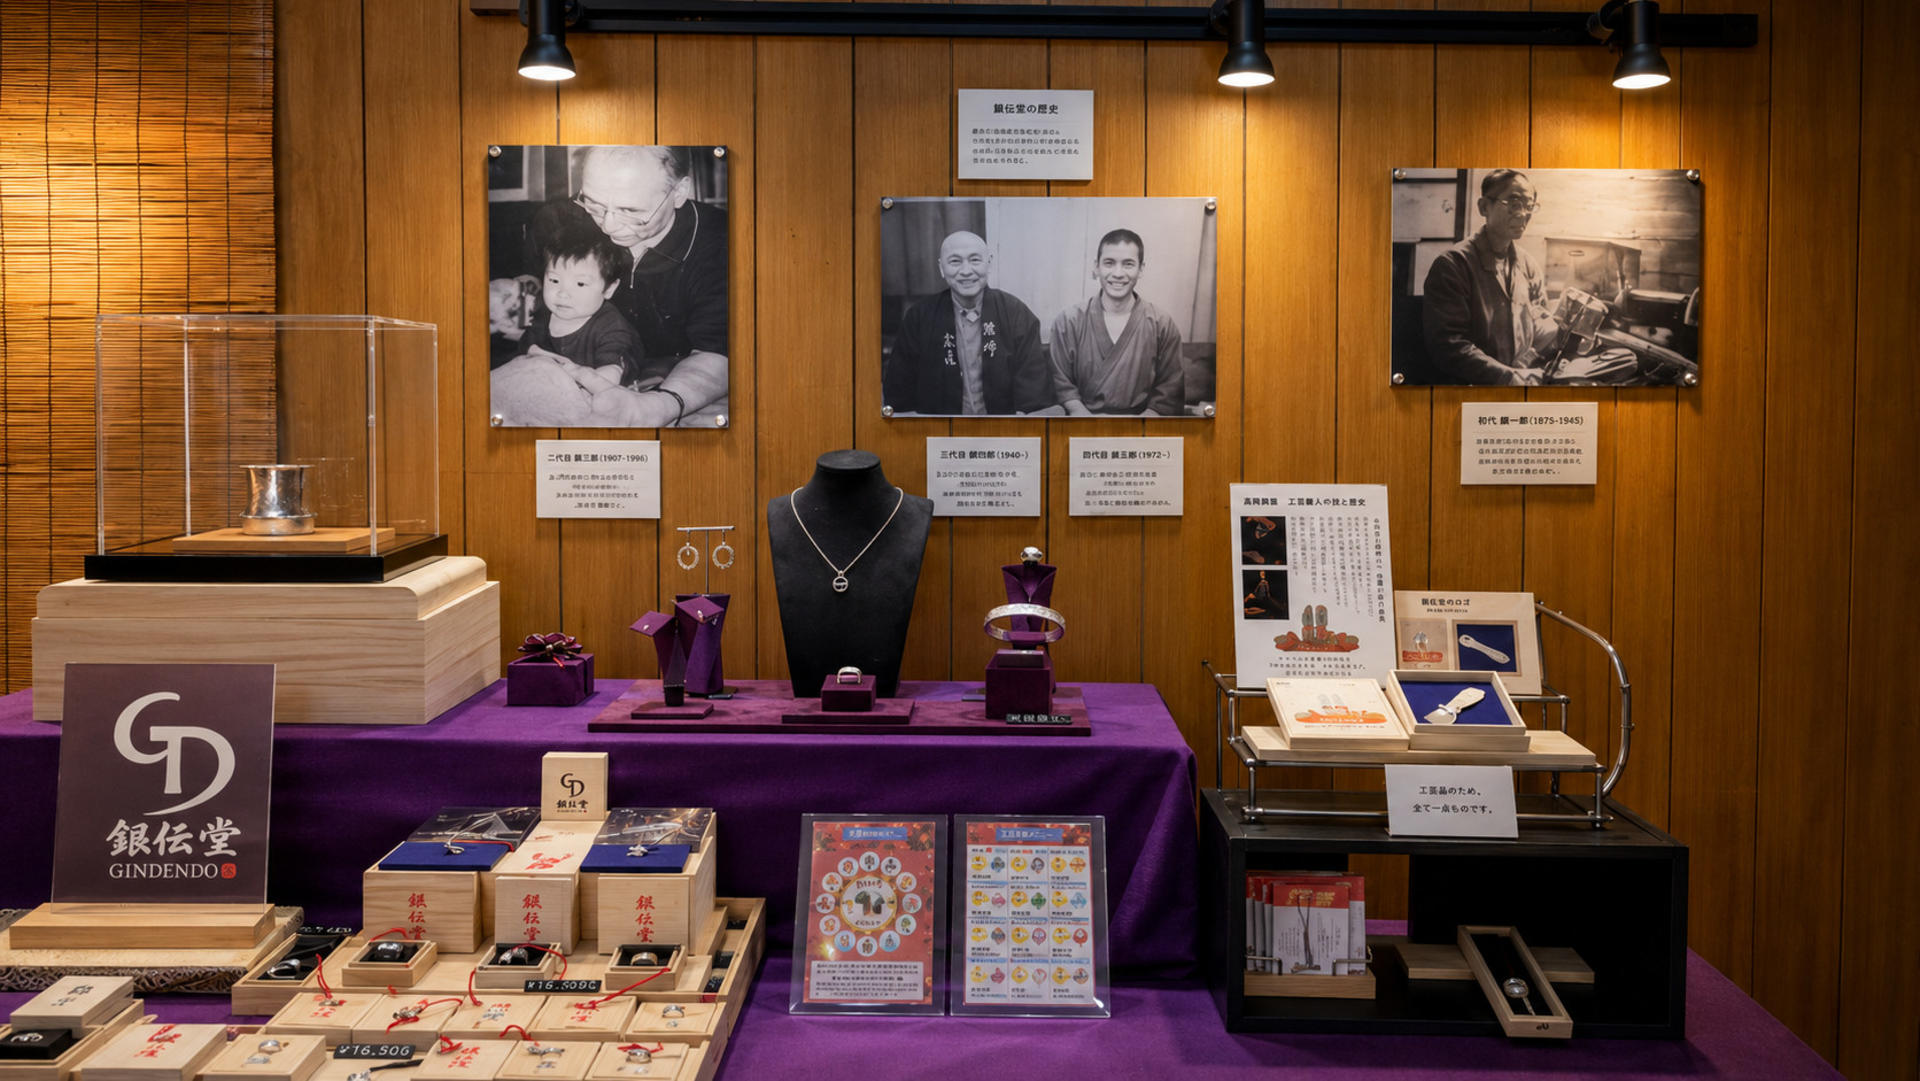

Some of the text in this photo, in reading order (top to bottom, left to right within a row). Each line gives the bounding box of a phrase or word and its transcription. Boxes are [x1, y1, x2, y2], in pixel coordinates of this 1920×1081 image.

[547, 454, 572, 462] 二代目
[1412, 803, 1493, 814] 全て一点ものです。
[105, 816, 241, 857] 銀伝堂
[109, 863, 218, 879] GINDENDO
